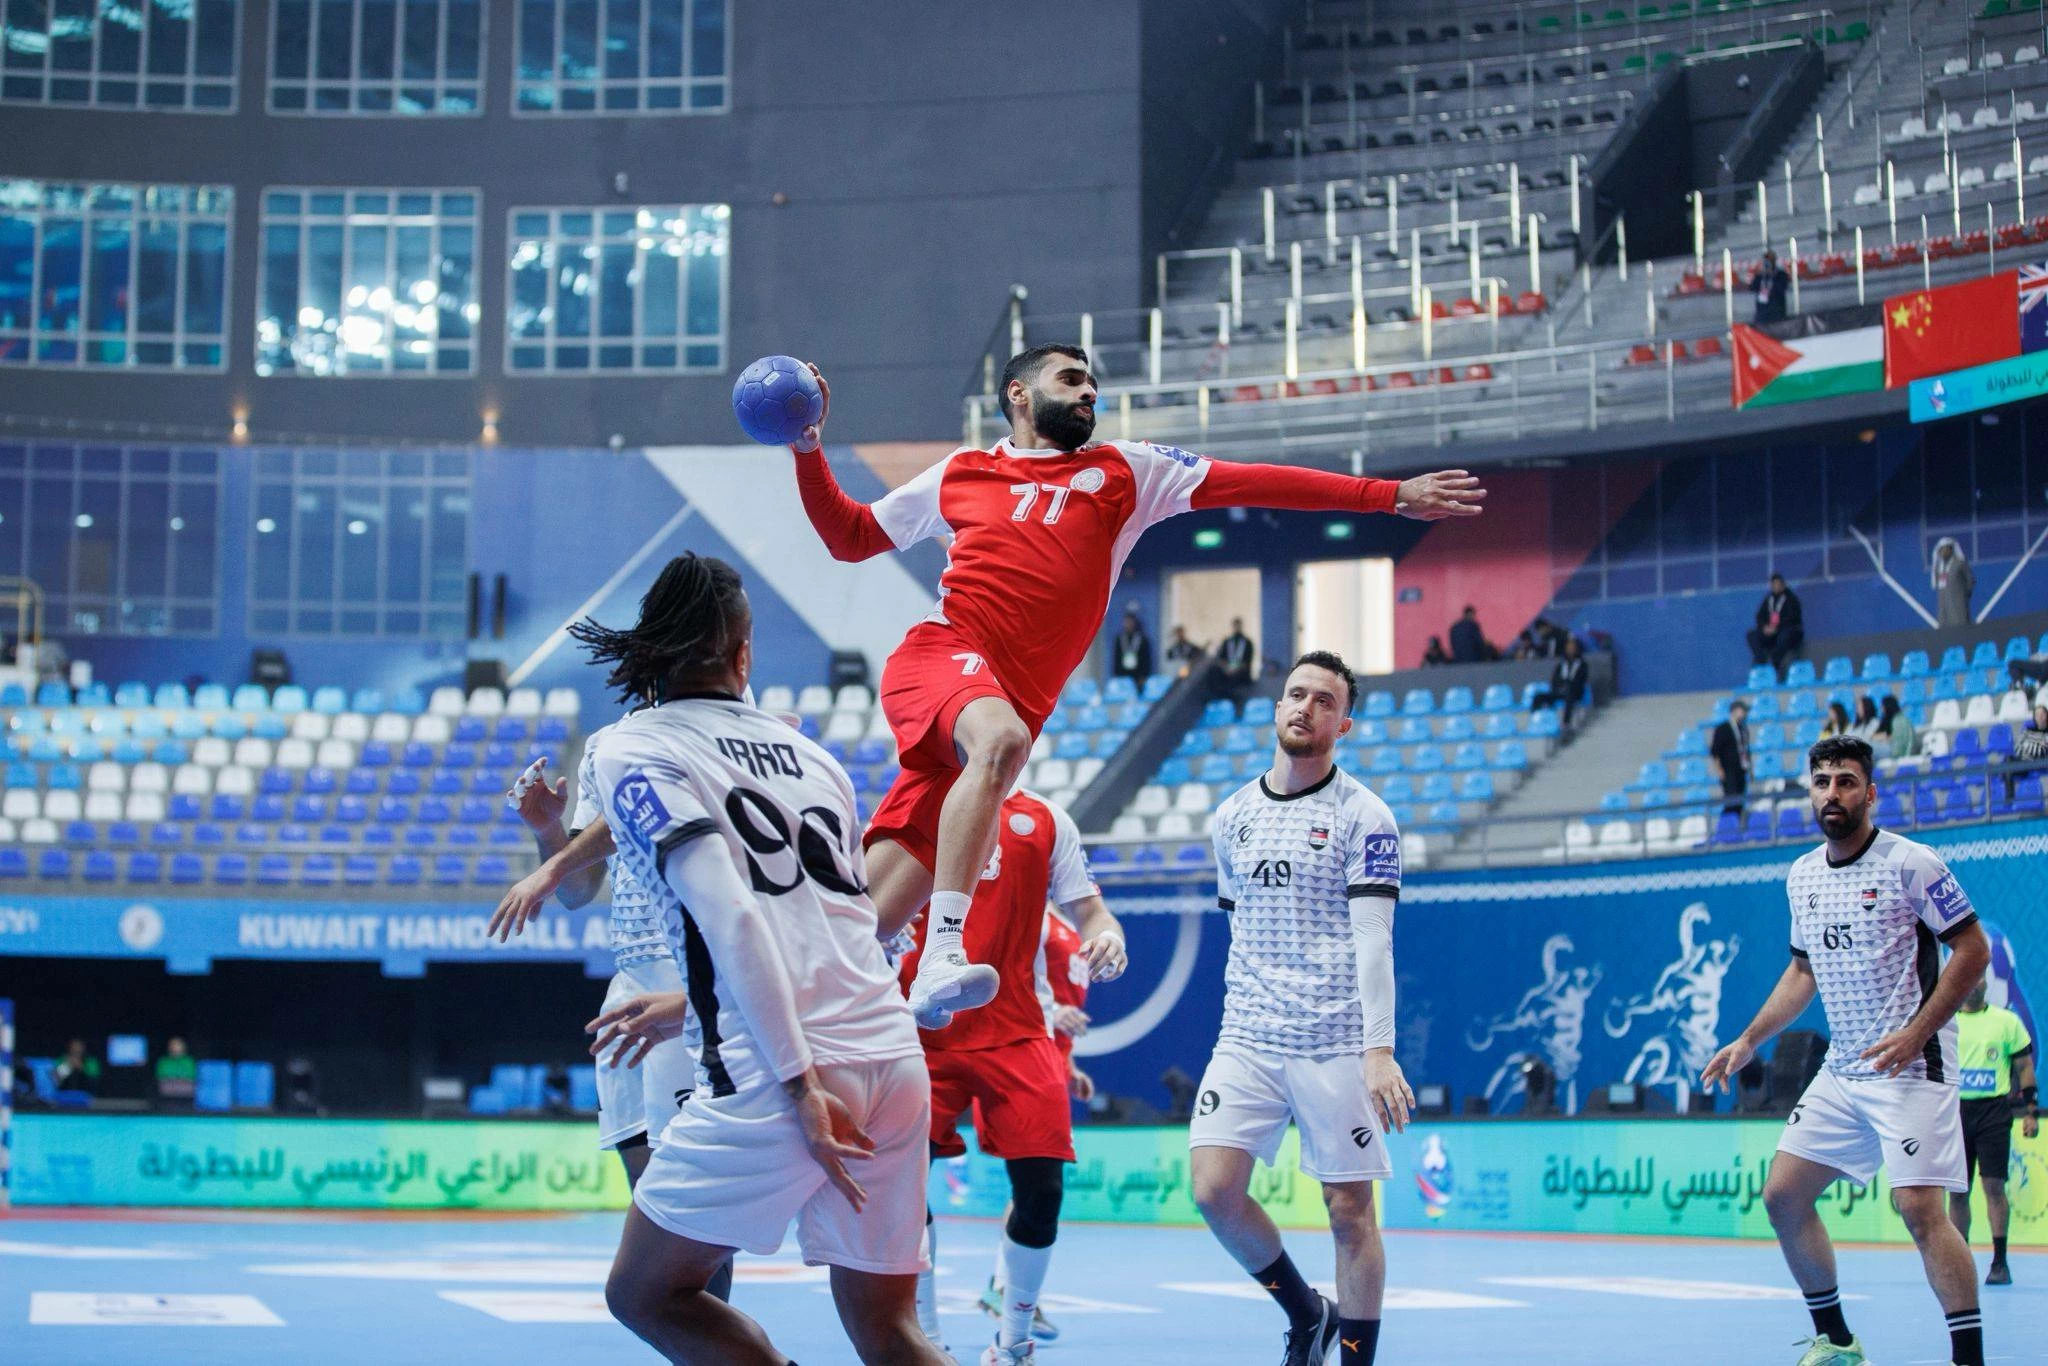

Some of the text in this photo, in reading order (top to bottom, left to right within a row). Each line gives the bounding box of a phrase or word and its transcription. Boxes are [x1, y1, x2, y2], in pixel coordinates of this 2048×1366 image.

[1010, 482, 1070, 524] 77
[715, 738, 803, 779] IRAQ
[1251, 859, 1292, 888] 49
[239, 914, 380, 948] KUWAIT
[582, 916, 611, 950] A
[1199, 1090, 1221, 1116] 9
[1541, 1154, 1655, 1210] للبطولة
